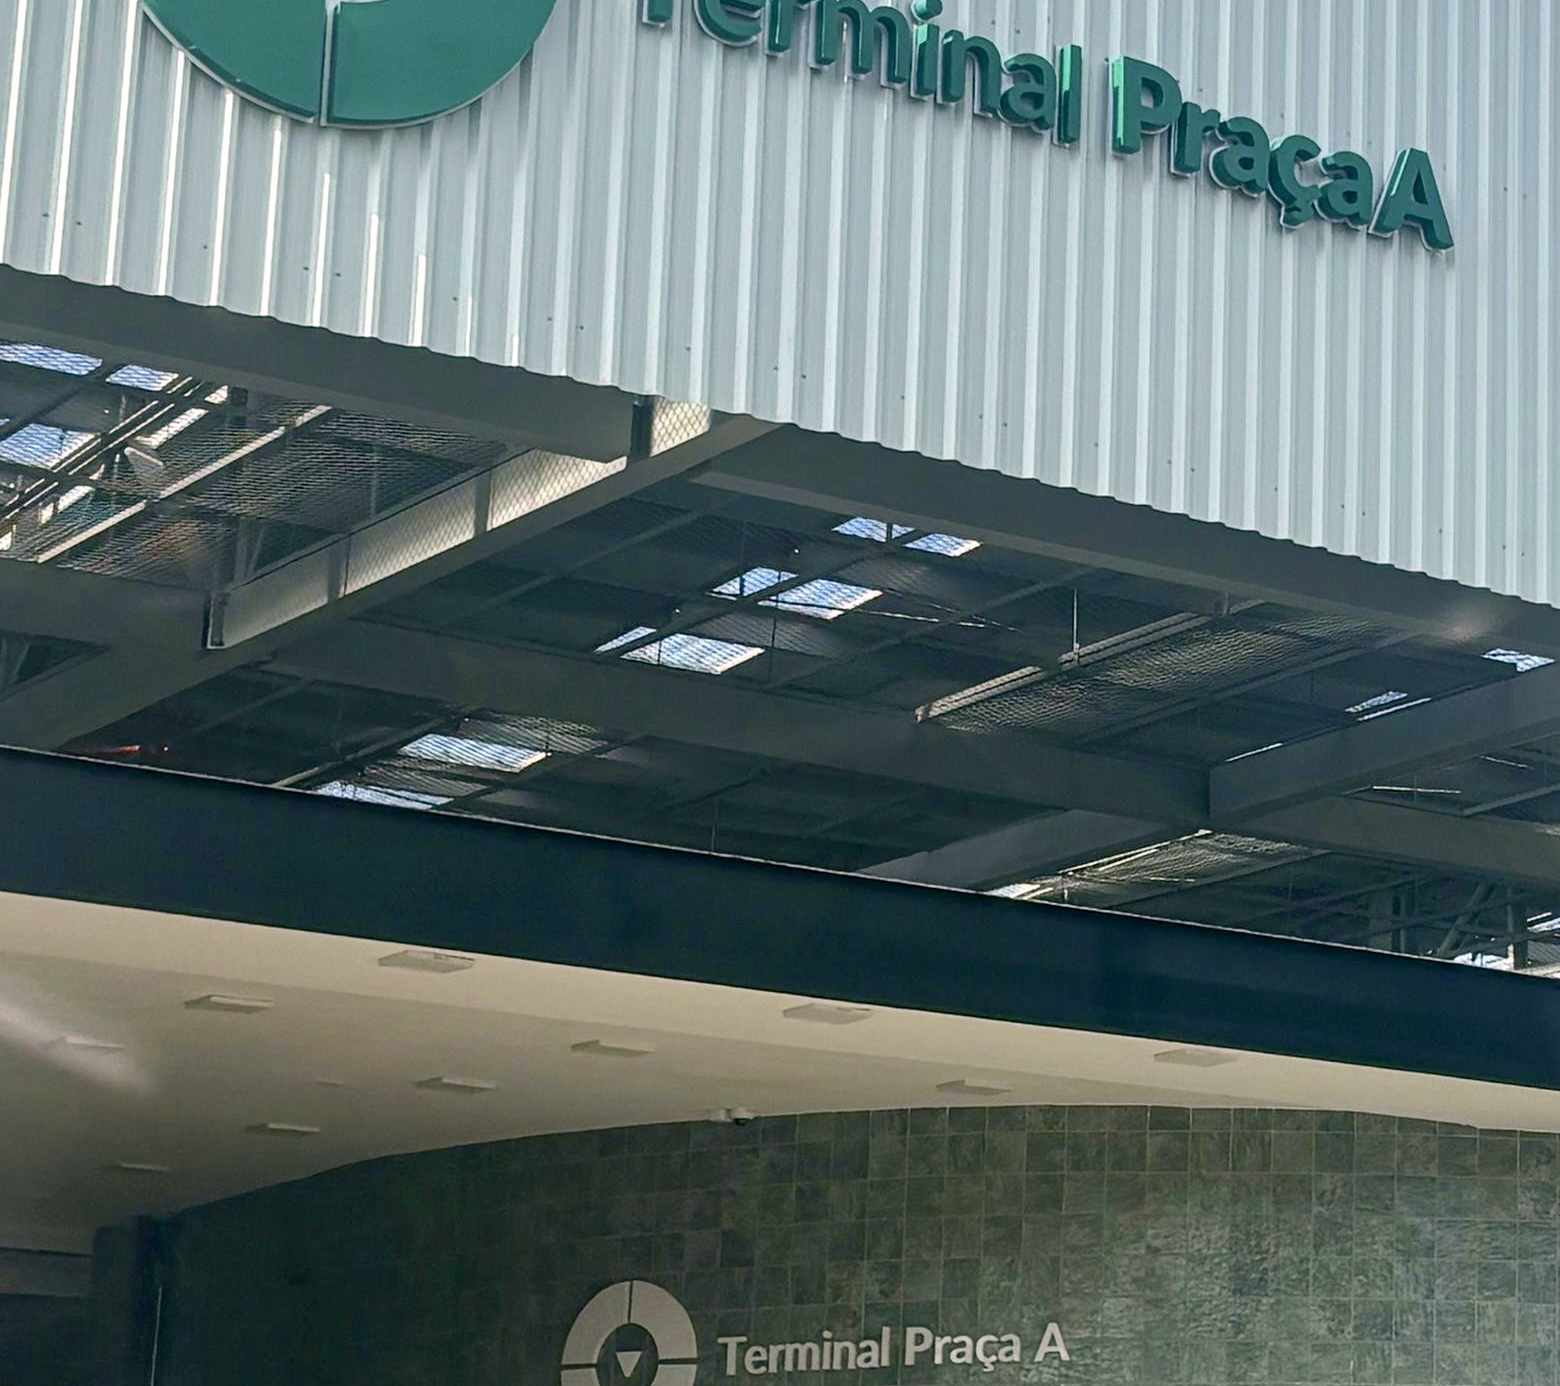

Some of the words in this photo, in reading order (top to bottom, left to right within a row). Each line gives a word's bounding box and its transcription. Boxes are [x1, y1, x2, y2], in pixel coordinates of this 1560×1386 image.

[718, 1326, 891, 1376] Terminal
[905, 1325, 1021, 1373] Praça
[1034, 1322, 1071, 1363] A
